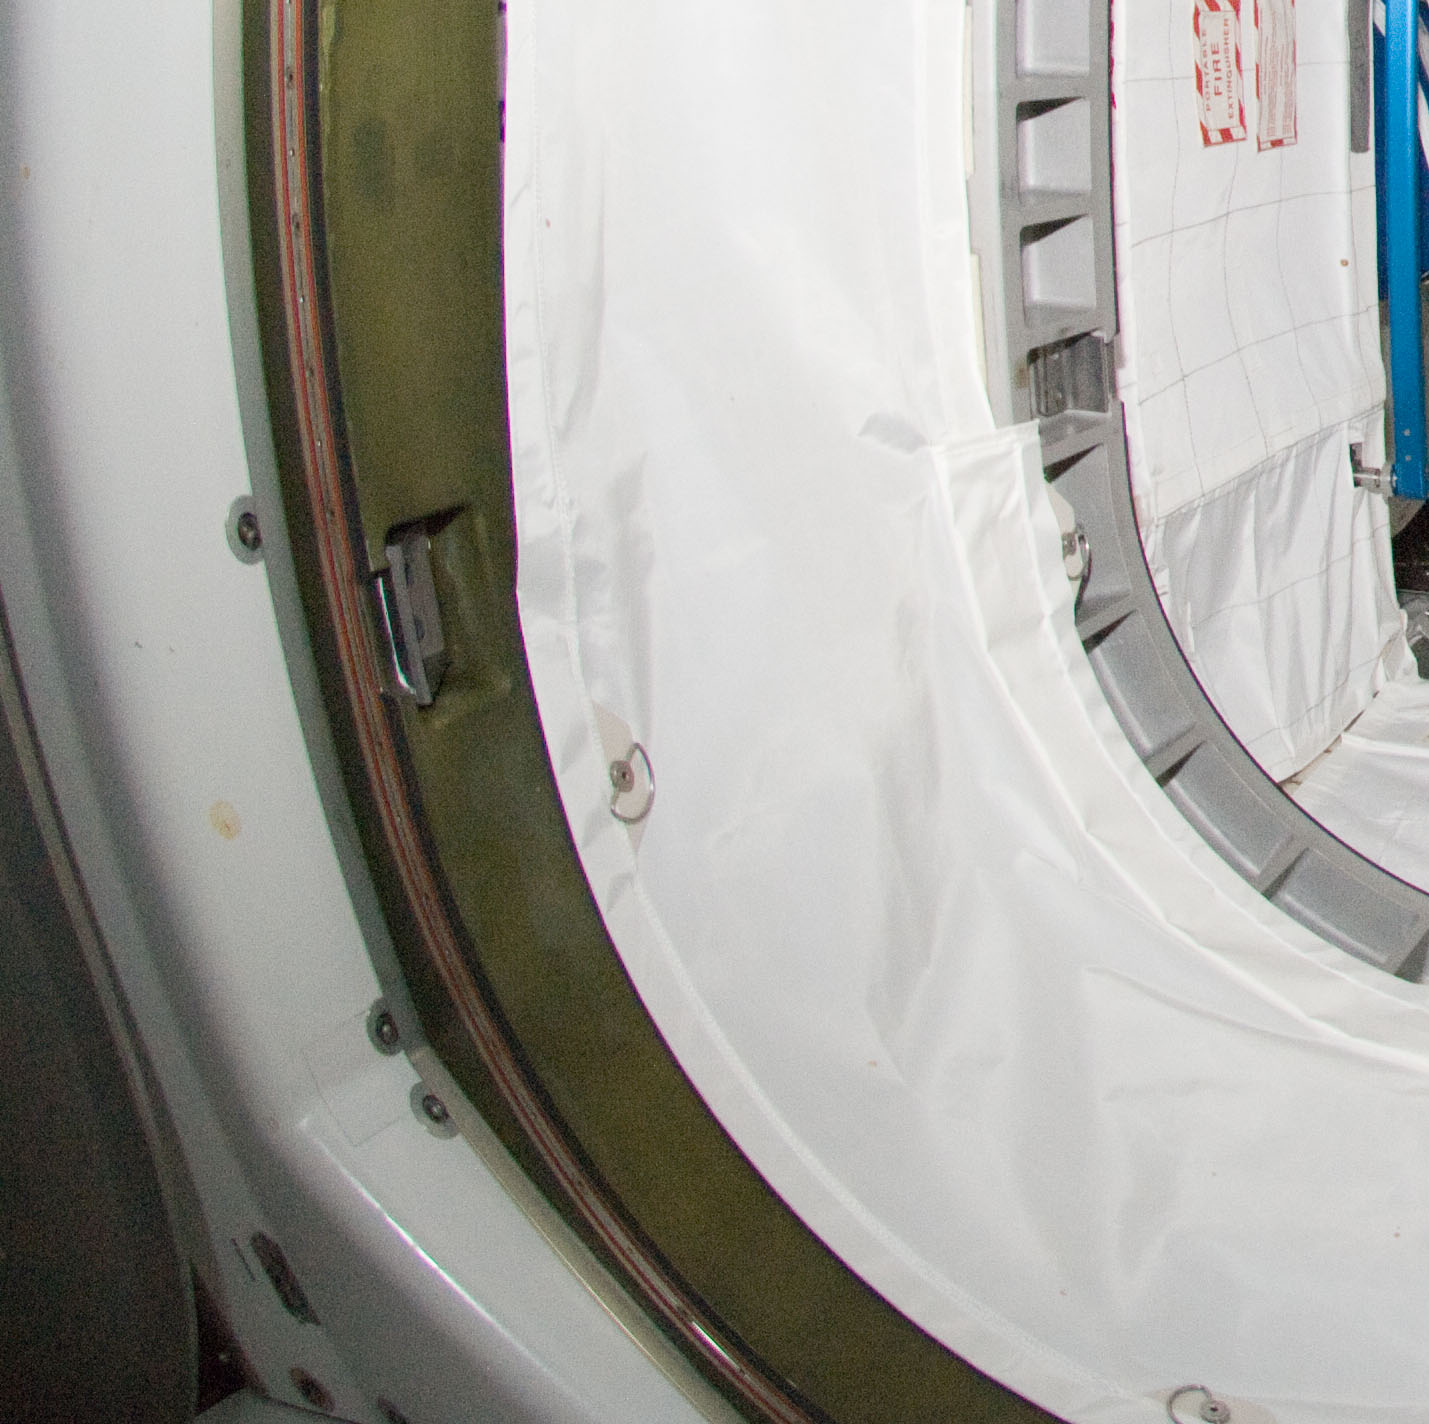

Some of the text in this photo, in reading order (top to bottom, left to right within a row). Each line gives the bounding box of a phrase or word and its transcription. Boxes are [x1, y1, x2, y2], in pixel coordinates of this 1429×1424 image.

[1201, 28, 1211, 112] PORTABLE
[1211, 42, 1223, 96] FIRE
[1223, 18, 1234, 119] EXTINGUISHER
